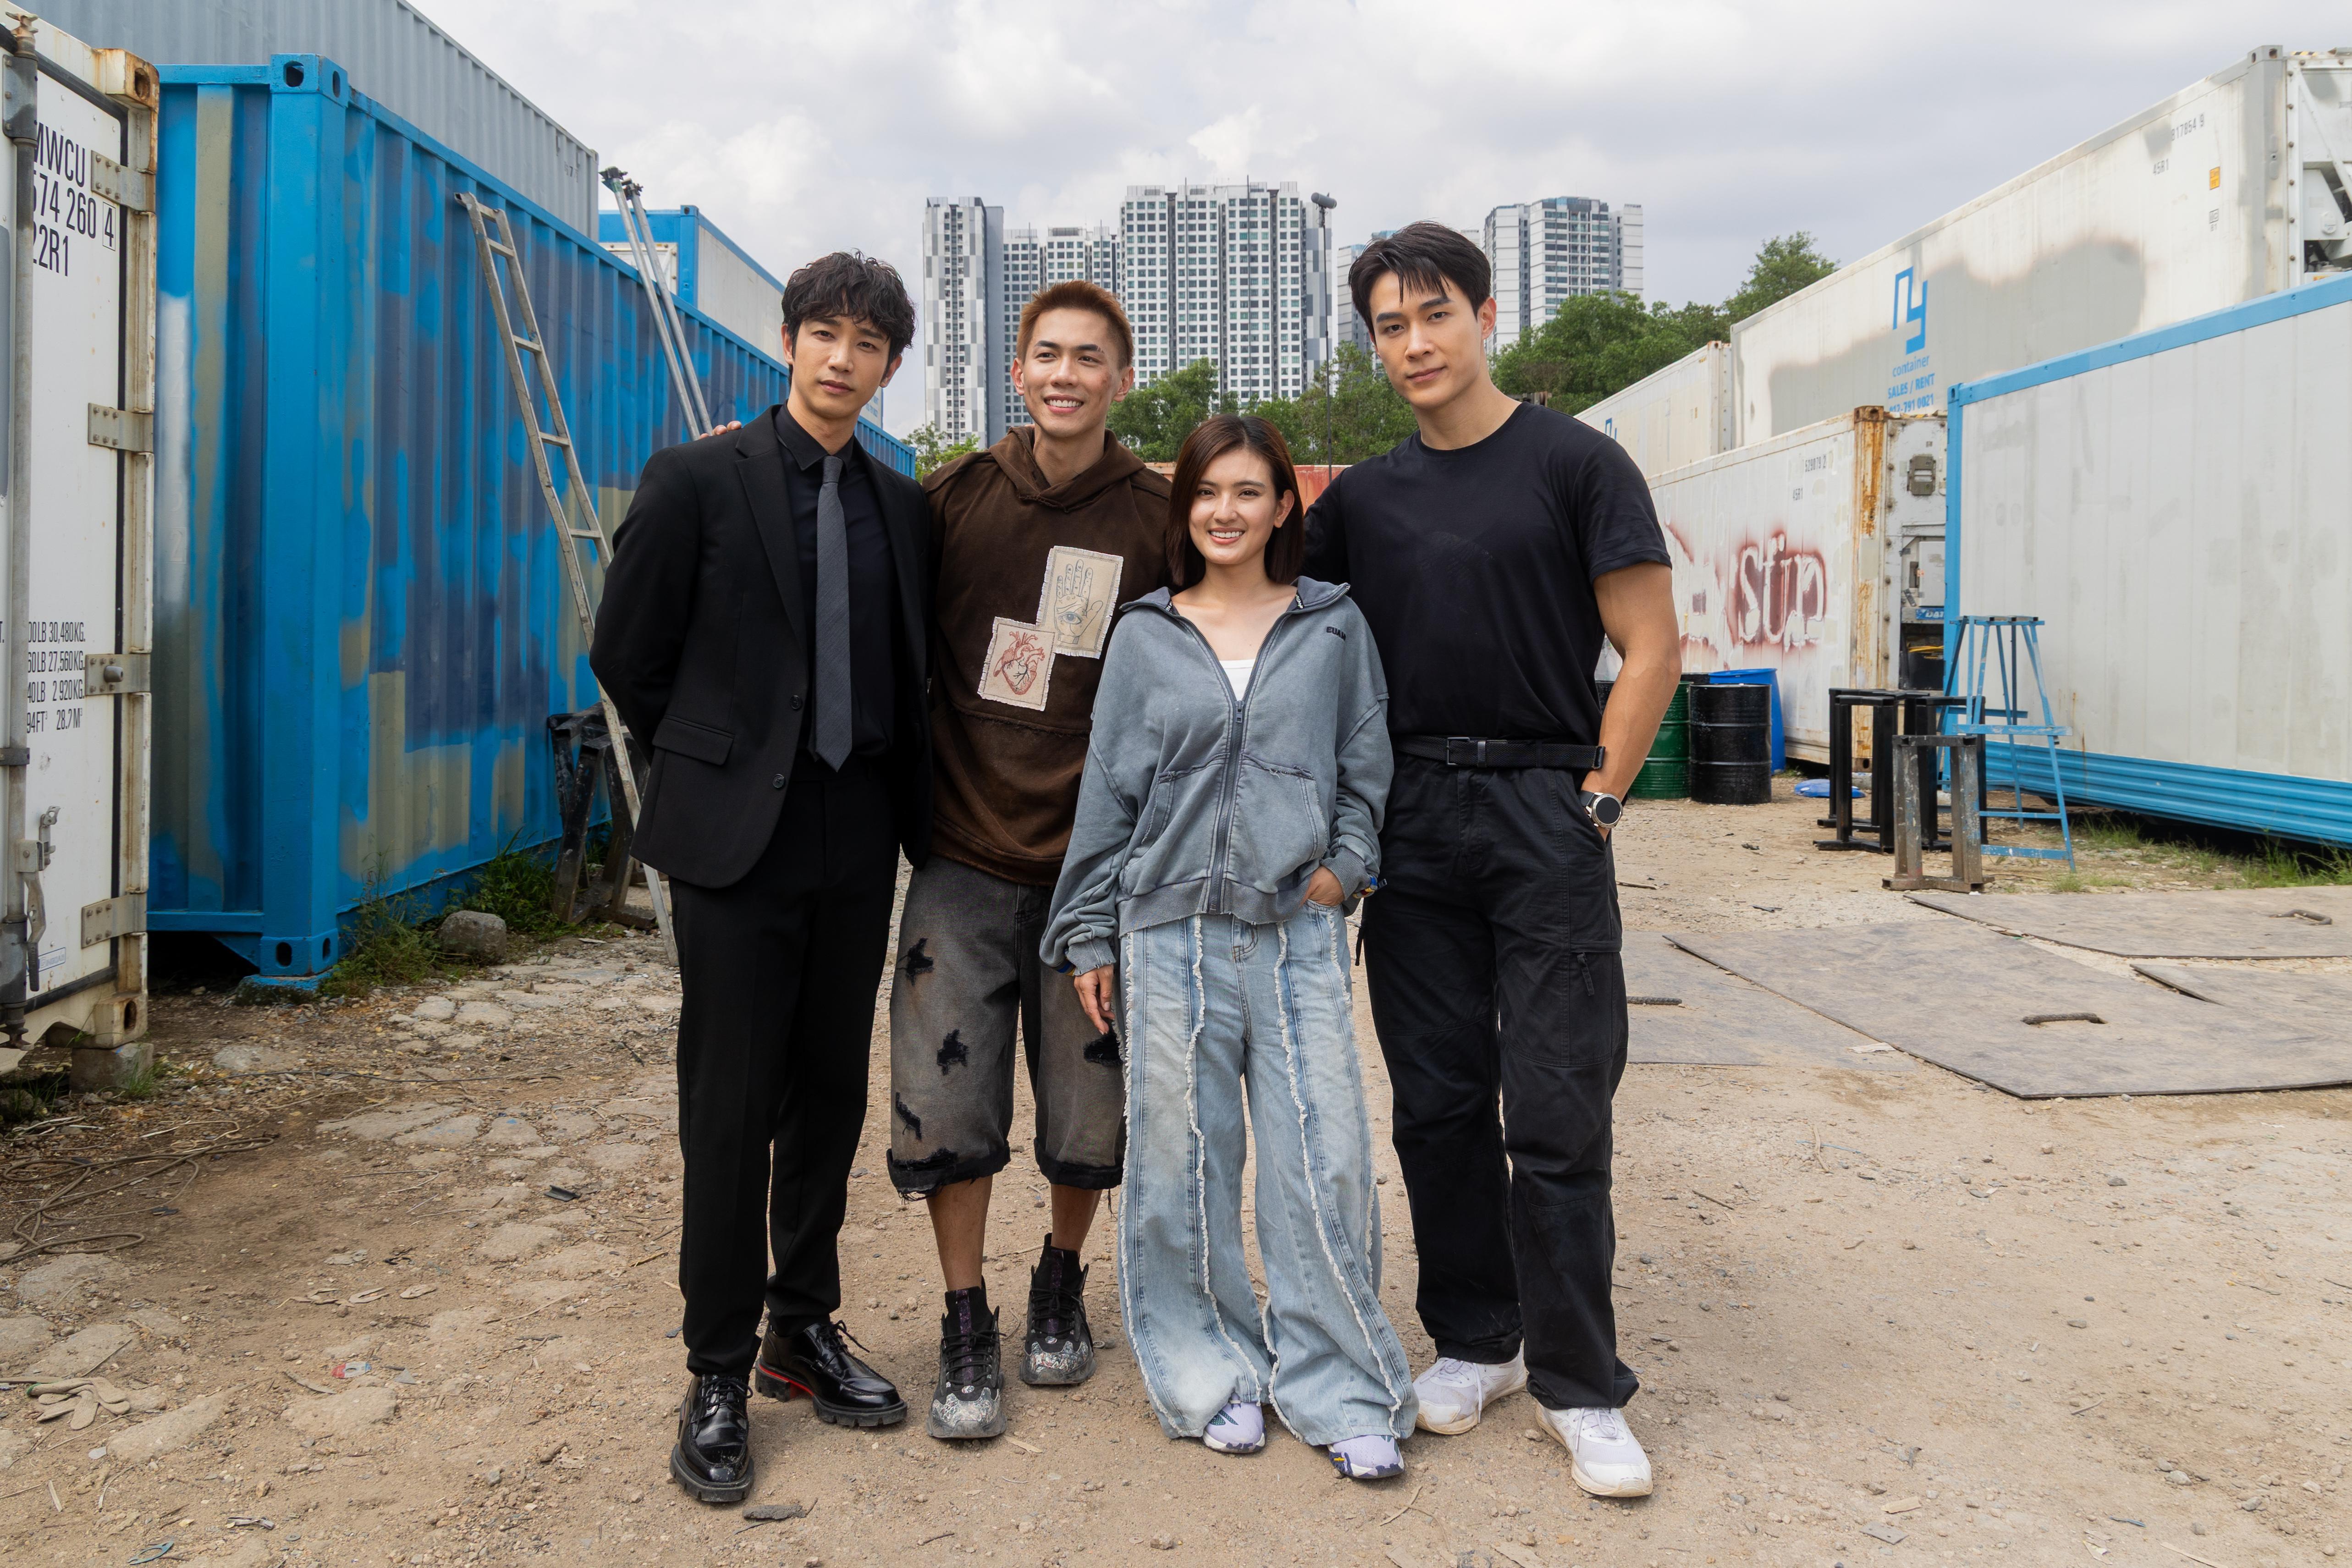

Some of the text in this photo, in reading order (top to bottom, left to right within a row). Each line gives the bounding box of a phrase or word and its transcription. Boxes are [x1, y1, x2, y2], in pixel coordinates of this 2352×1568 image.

[66, 187, 96, 239] 260
[105, 207, 114, 248] 4
[1892, 355, 1930, 377] container
[1888, 380, 1908, 400] SALES
[1915, 373, 1935, 391] RENT
[1917, 393, 1934, 409] 0021
